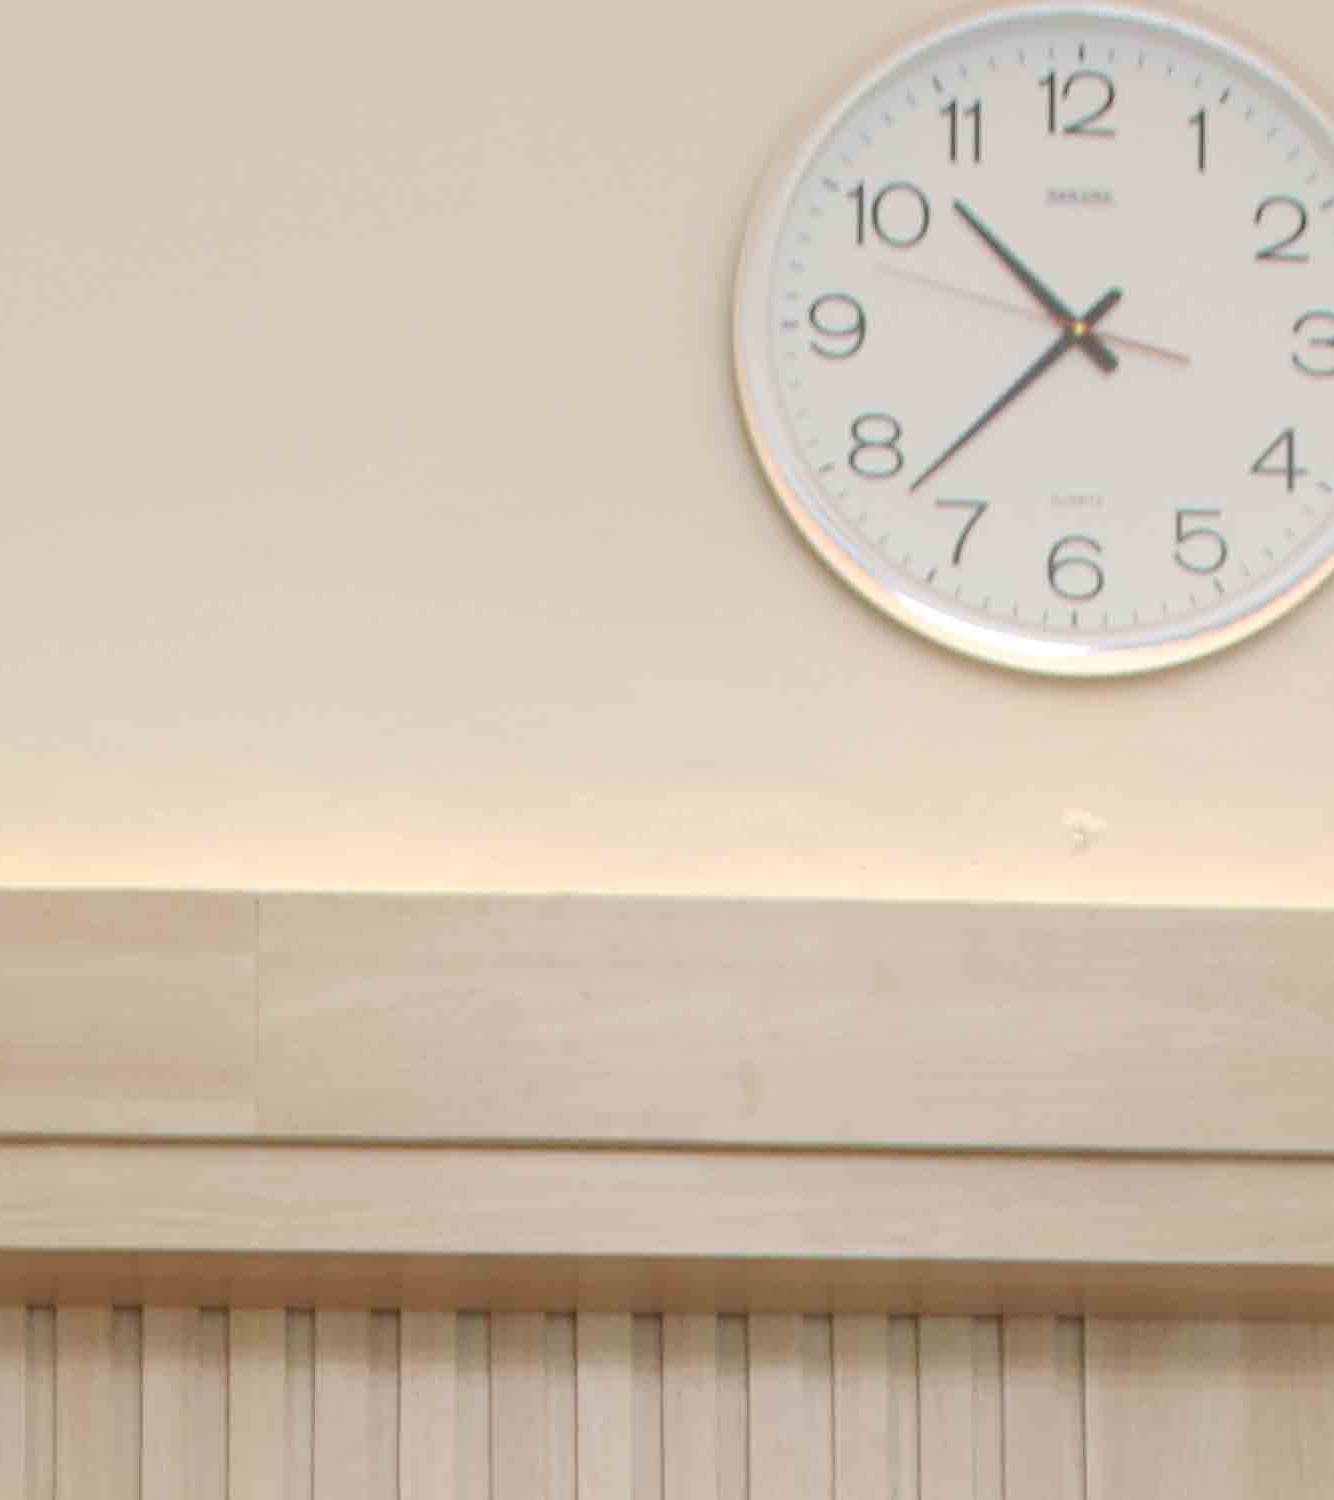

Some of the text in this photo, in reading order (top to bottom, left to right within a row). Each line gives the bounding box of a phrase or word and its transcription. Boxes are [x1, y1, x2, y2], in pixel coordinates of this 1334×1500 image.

[939, 98, 981, 164] 11
[1039, 70, 1116, 136] 12
[1189, 107, 1206, 172] 1
[847, 180, 930, 249] 10
[1253, 195, 1310, 262] 2
[808, 292, 866, 360] 9
[847, 411, 904, 480] 8
[1250, 428, 1308, 493] 4
[934, 499, 987, 565] 7
[1172, 508, 1227, 574] 5
[1047, 534, 1104, 602] 6
